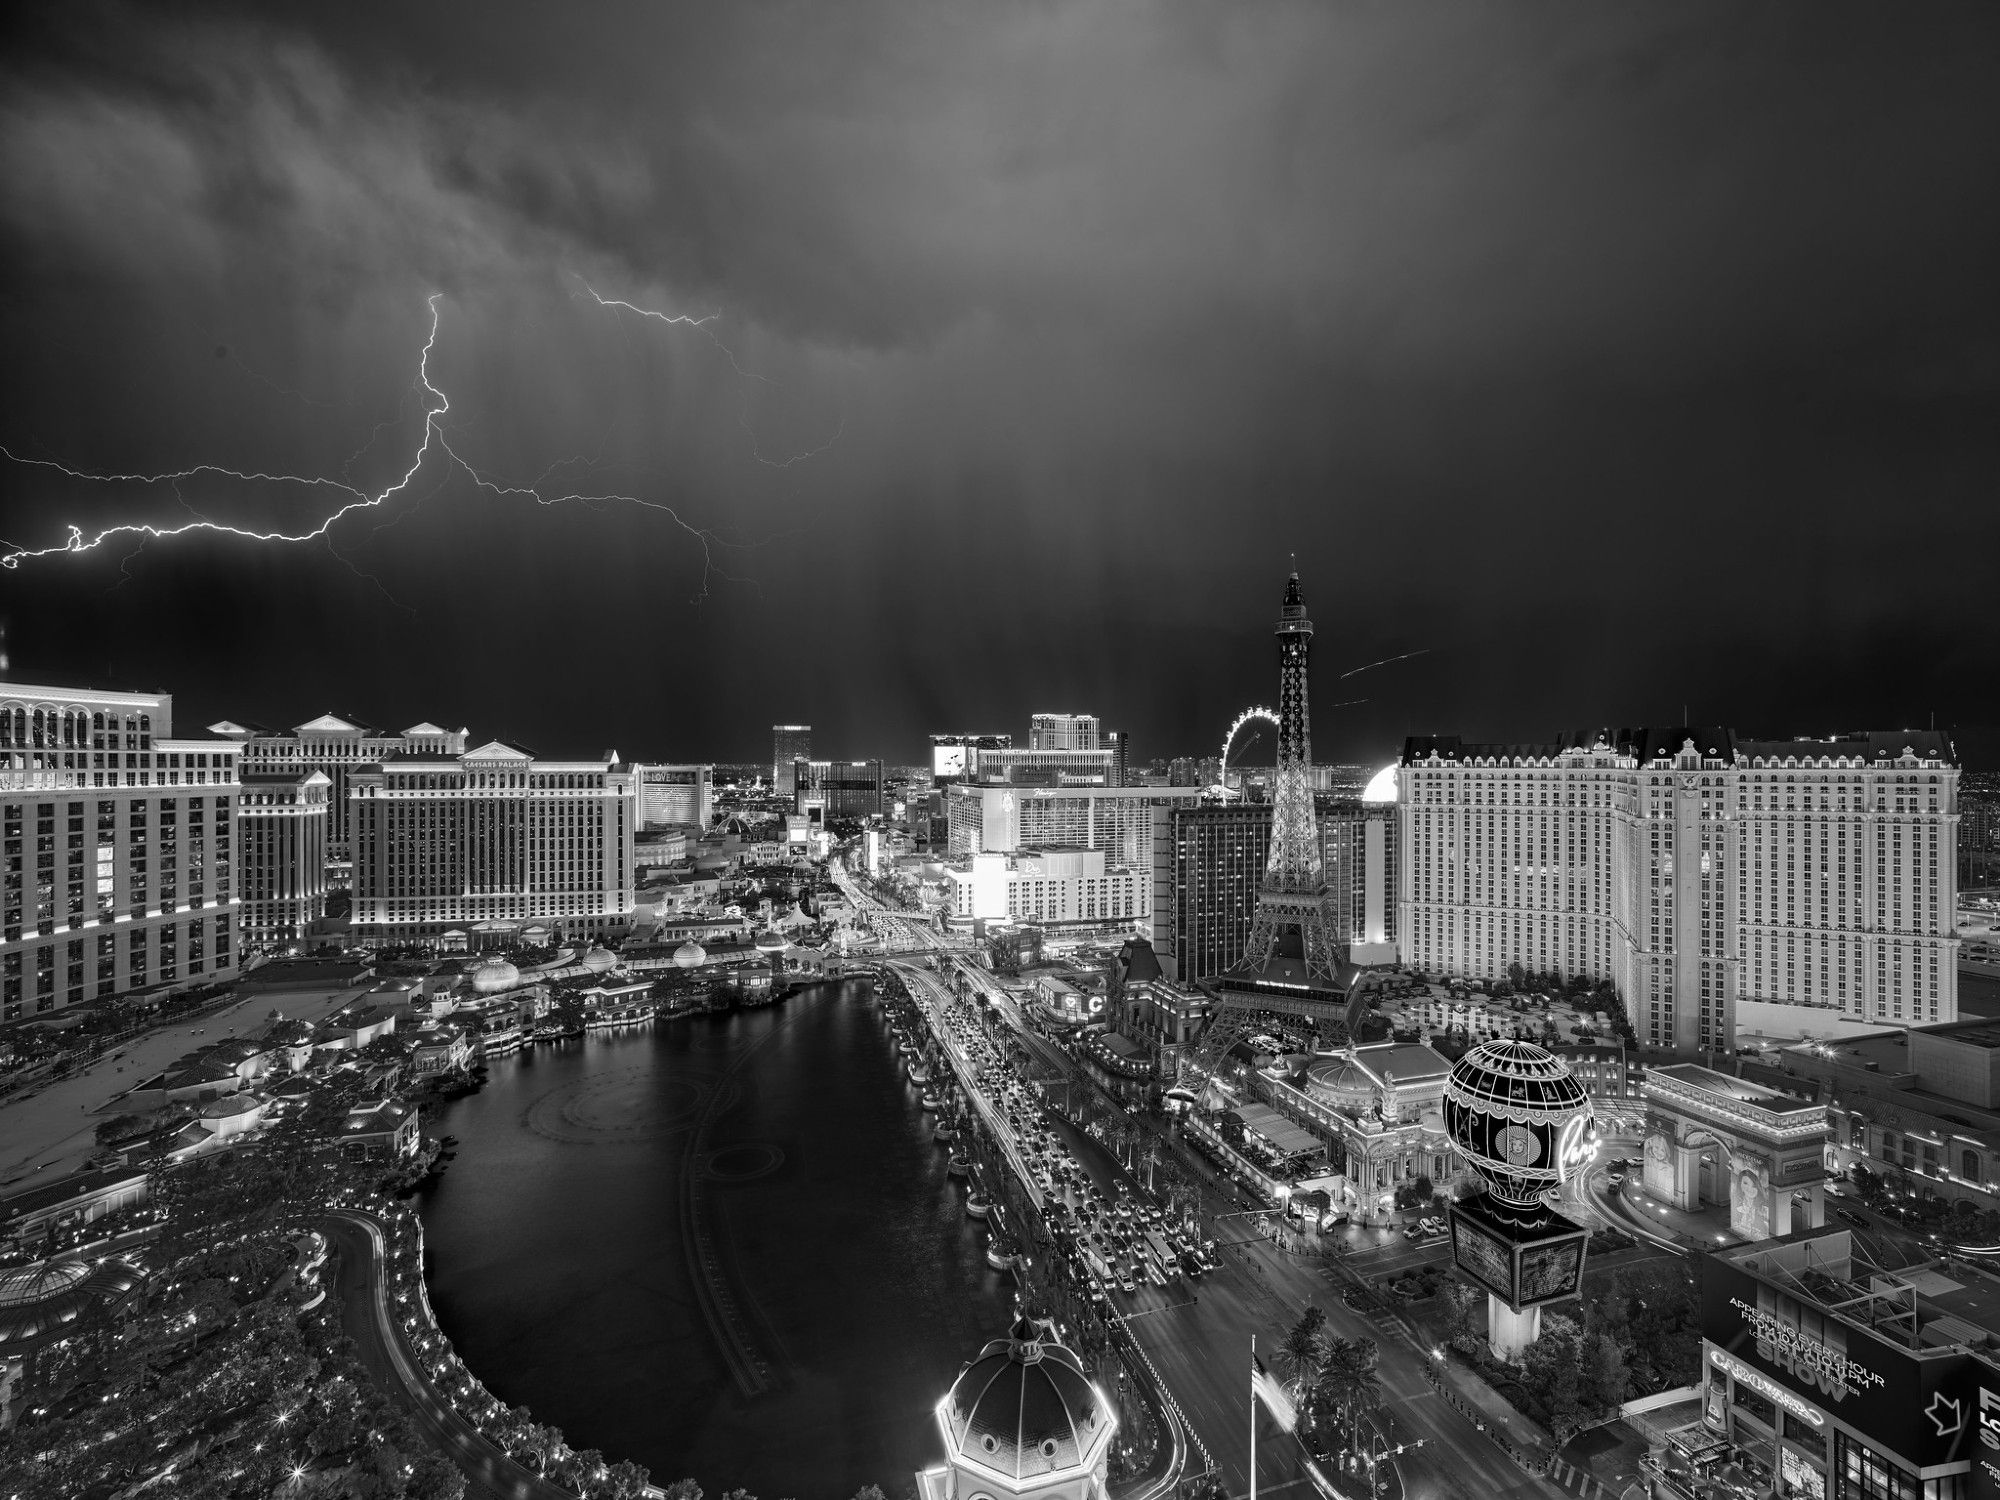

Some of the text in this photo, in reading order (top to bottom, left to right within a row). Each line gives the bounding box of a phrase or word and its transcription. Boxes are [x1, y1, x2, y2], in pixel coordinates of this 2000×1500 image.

[652, 773, 671, 781] LOVE
[1559, 1115, 1602, 1183] Paris
[1729, 1298, 1885, 1387] APPEARING EVERY HOUR
[1741, 1311, 1775, 1336] FROM
[1777, 1331, 1790, 1343] 10
[1848, 1370, 1869, 1389] PM
[1757, 1340, 1848, 1402] SHOW
